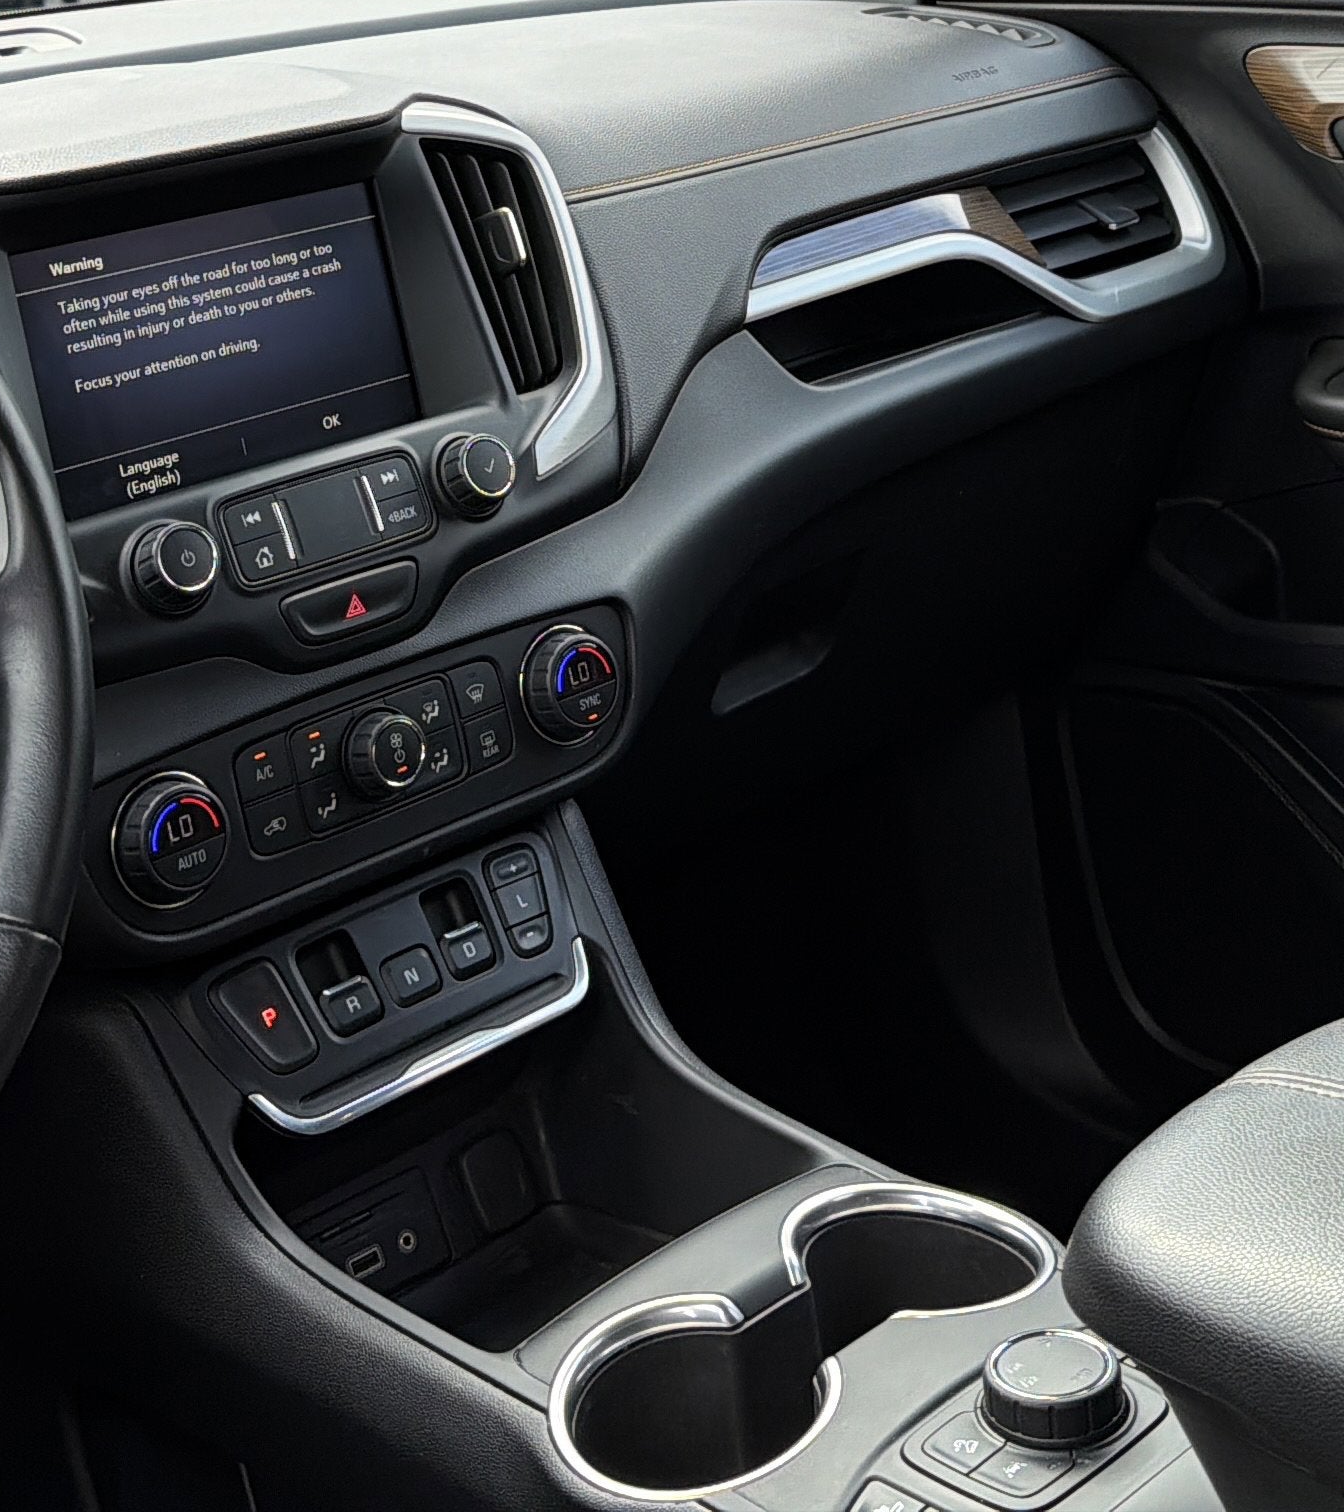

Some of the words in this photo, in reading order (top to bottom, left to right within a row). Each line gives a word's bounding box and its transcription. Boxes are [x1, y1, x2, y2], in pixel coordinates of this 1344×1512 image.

[952, 65, 999, 82] AIRBAG
[49, 256, 104, 277] Warning
[57, 296, 100, 314] Taking
[101, 290, 129, 309] your
[131, 283, 160, 303] eyes
[161, 275, 180, 291] off
[180, 272, 201, 287] the
[203, 264, 231, 282] road
[231, 261, 249, 275] for
[251, 258, 271, 271] too
[271, 252, 298, 267] long
[299, 249, 312, 260] or
[313, 244, 333, 256] too
[63, 317, 97, 335] often
[99, 308, 131, 326] while
[133, 302, 166, 319] using
[167, 294, 190, 310] this
[192, 285, 233, 307] system
[234, 274, 267, 294] could
[267, 270, 301, 286] cause
[302, 267, 310, 278] a
[311, 258, 342, 276] crash
[67, 332, 122, 354] resulting
[123, 328, 136, 341] in
[137, 320, 170, 339] injury
[172, 317, 185, 329] or
[188, 305, 223, 325] death
[223, 304, 237, 316] to
[238, 299, 260, 316] you
[261, 295, 274, 307] or
[276, 285, 316, 304] others.
[74, 375, 113, 394] Focus
[113, 368, 142, 387] your
[144, 352, 199, 376] attention
[201, 349, 216, 361] on
[218, 338, 261, 357] driving.
[322, 413, 342, 430] OK
[119, 449, 180, 479] Language
[126, 468, 182, 500] (English)
[395, 505, 418, 523] BACK
[568, 661, 592, 686] LO
[579, 693, 602, 712] SYNC
[482, 743, 501, 759] REAR
[255, 763, 274, 782] A/C
[166, 813, 193, 844] LO
[177, 850, 207, 871] AUTO
[515, 893, 529, 909] L
[463, 941, 477, 958] D
[404, 967, 420, 985] N
[345, 995, 361, 1012] R
[261, 1006, 278, 1028] P
